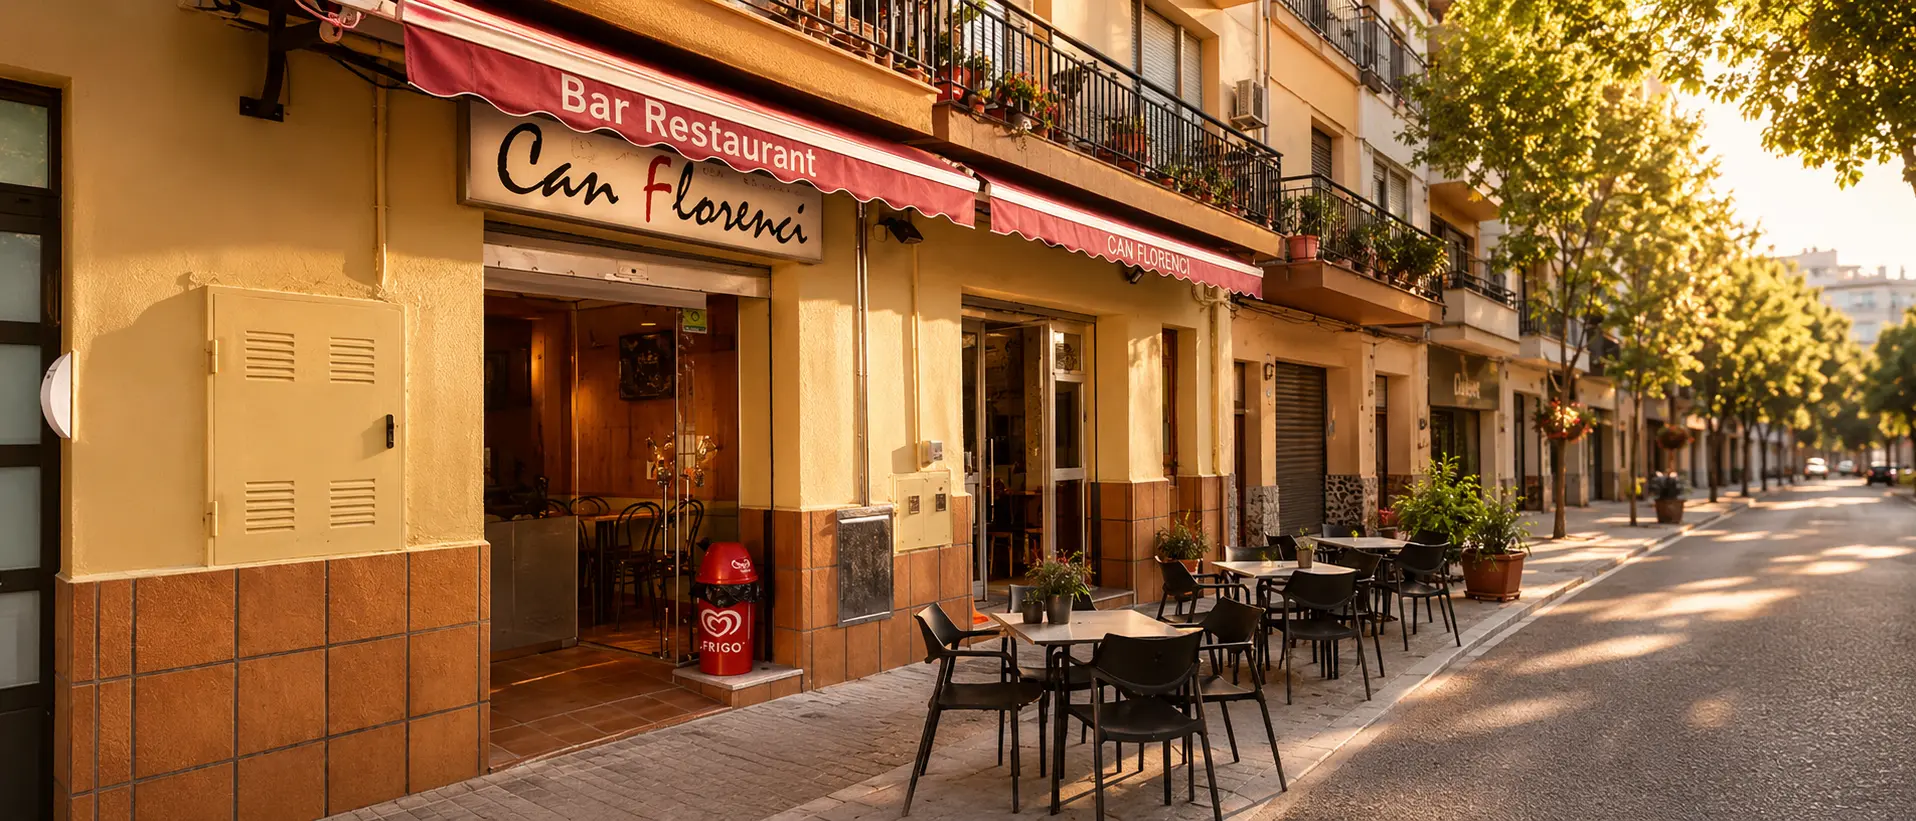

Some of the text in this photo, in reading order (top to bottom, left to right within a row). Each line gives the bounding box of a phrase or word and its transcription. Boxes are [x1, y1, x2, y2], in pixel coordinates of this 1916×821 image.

[561, 73, 629, 125] Bar
[645, 97, 817, 178] Restaurant
[497, 122, 808, 244] Can Florenci
[1107, 235, 1191, 275] CAN FLORENCI
[703, 640, 742, 654] FRIGO
